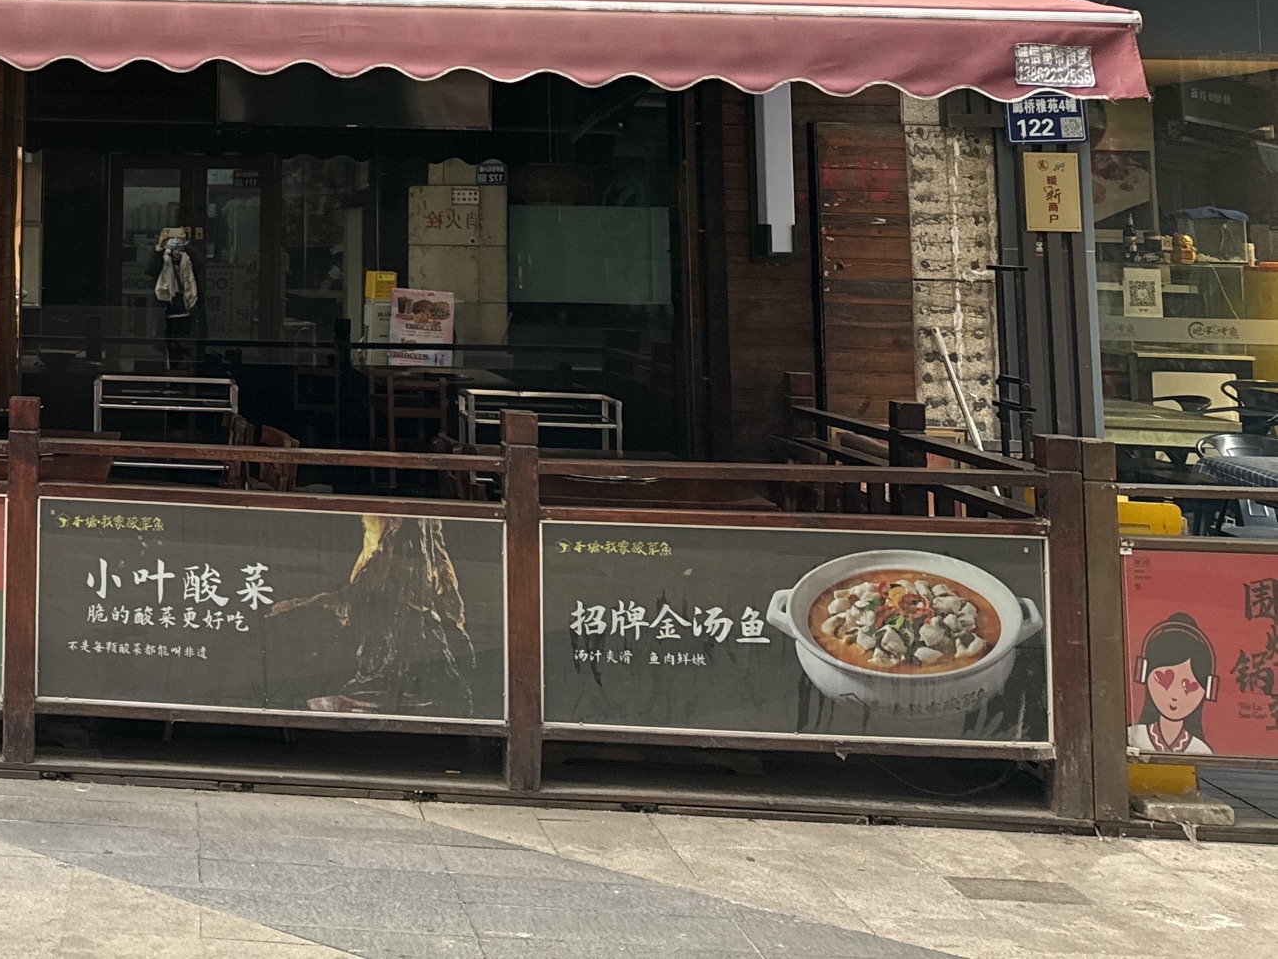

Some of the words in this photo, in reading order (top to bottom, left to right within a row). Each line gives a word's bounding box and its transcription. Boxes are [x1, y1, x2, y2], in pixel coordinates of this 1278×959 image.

[1017, 118, 1055, 138] 122
[86, 557, 274, 611] 小叶酸菜
[87, 603, 249, 632] 脆的酸菜更好吃
[570, 600, 771, 644] 招牌金汤鱼
[574, 649, 633, 664] 汤汁爽滑
[648, 651, 707, 666] 鱼肉鲜嫩
